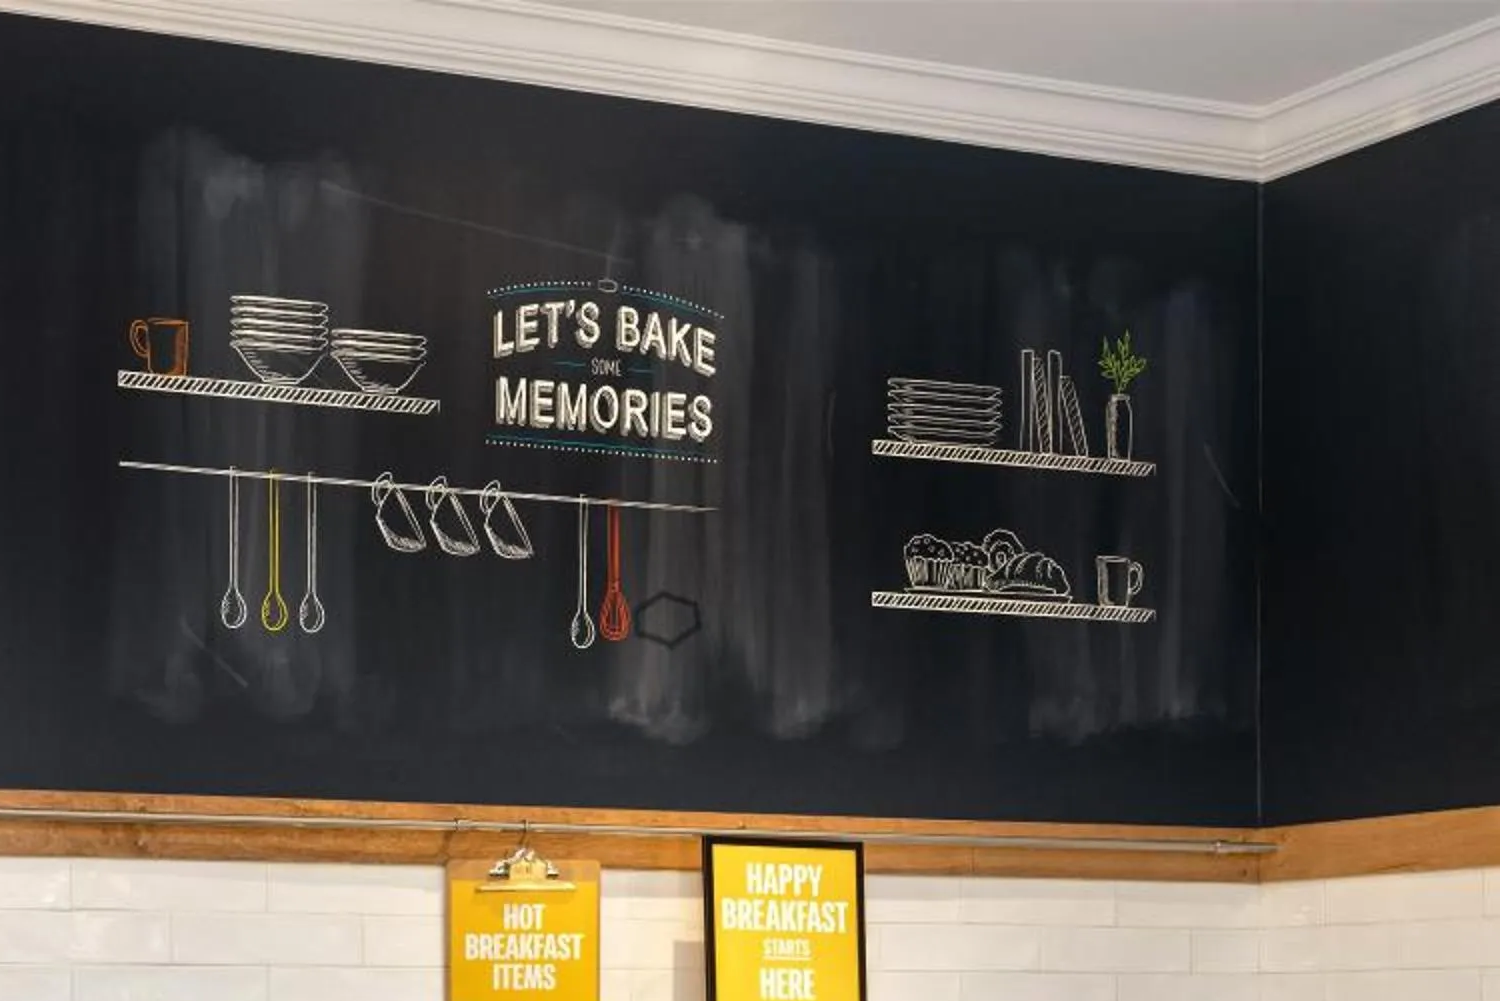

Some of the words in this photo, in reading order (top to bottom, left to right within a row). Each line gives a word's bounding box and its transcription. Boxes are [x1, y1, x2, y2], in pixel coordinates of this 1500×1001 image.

[493, 299, 601, 358] LET'S
[615, 305, 717, 377] BAKE
[591, 356, 622, 377] SOME
[495, 376, 713, 443] MEMORIES
[745, 862, 823, 897] HAPPY
[503, 903, 546, 930] HOT
[721, 897, 849, 933] BREAKFAST
[465, 933, 585, 961] BREAKFAST
[762, 938, 811, 957] STARTS
[493, 964, 557, 990] ITEMS
[759, 967, 817, 1001] HERE
